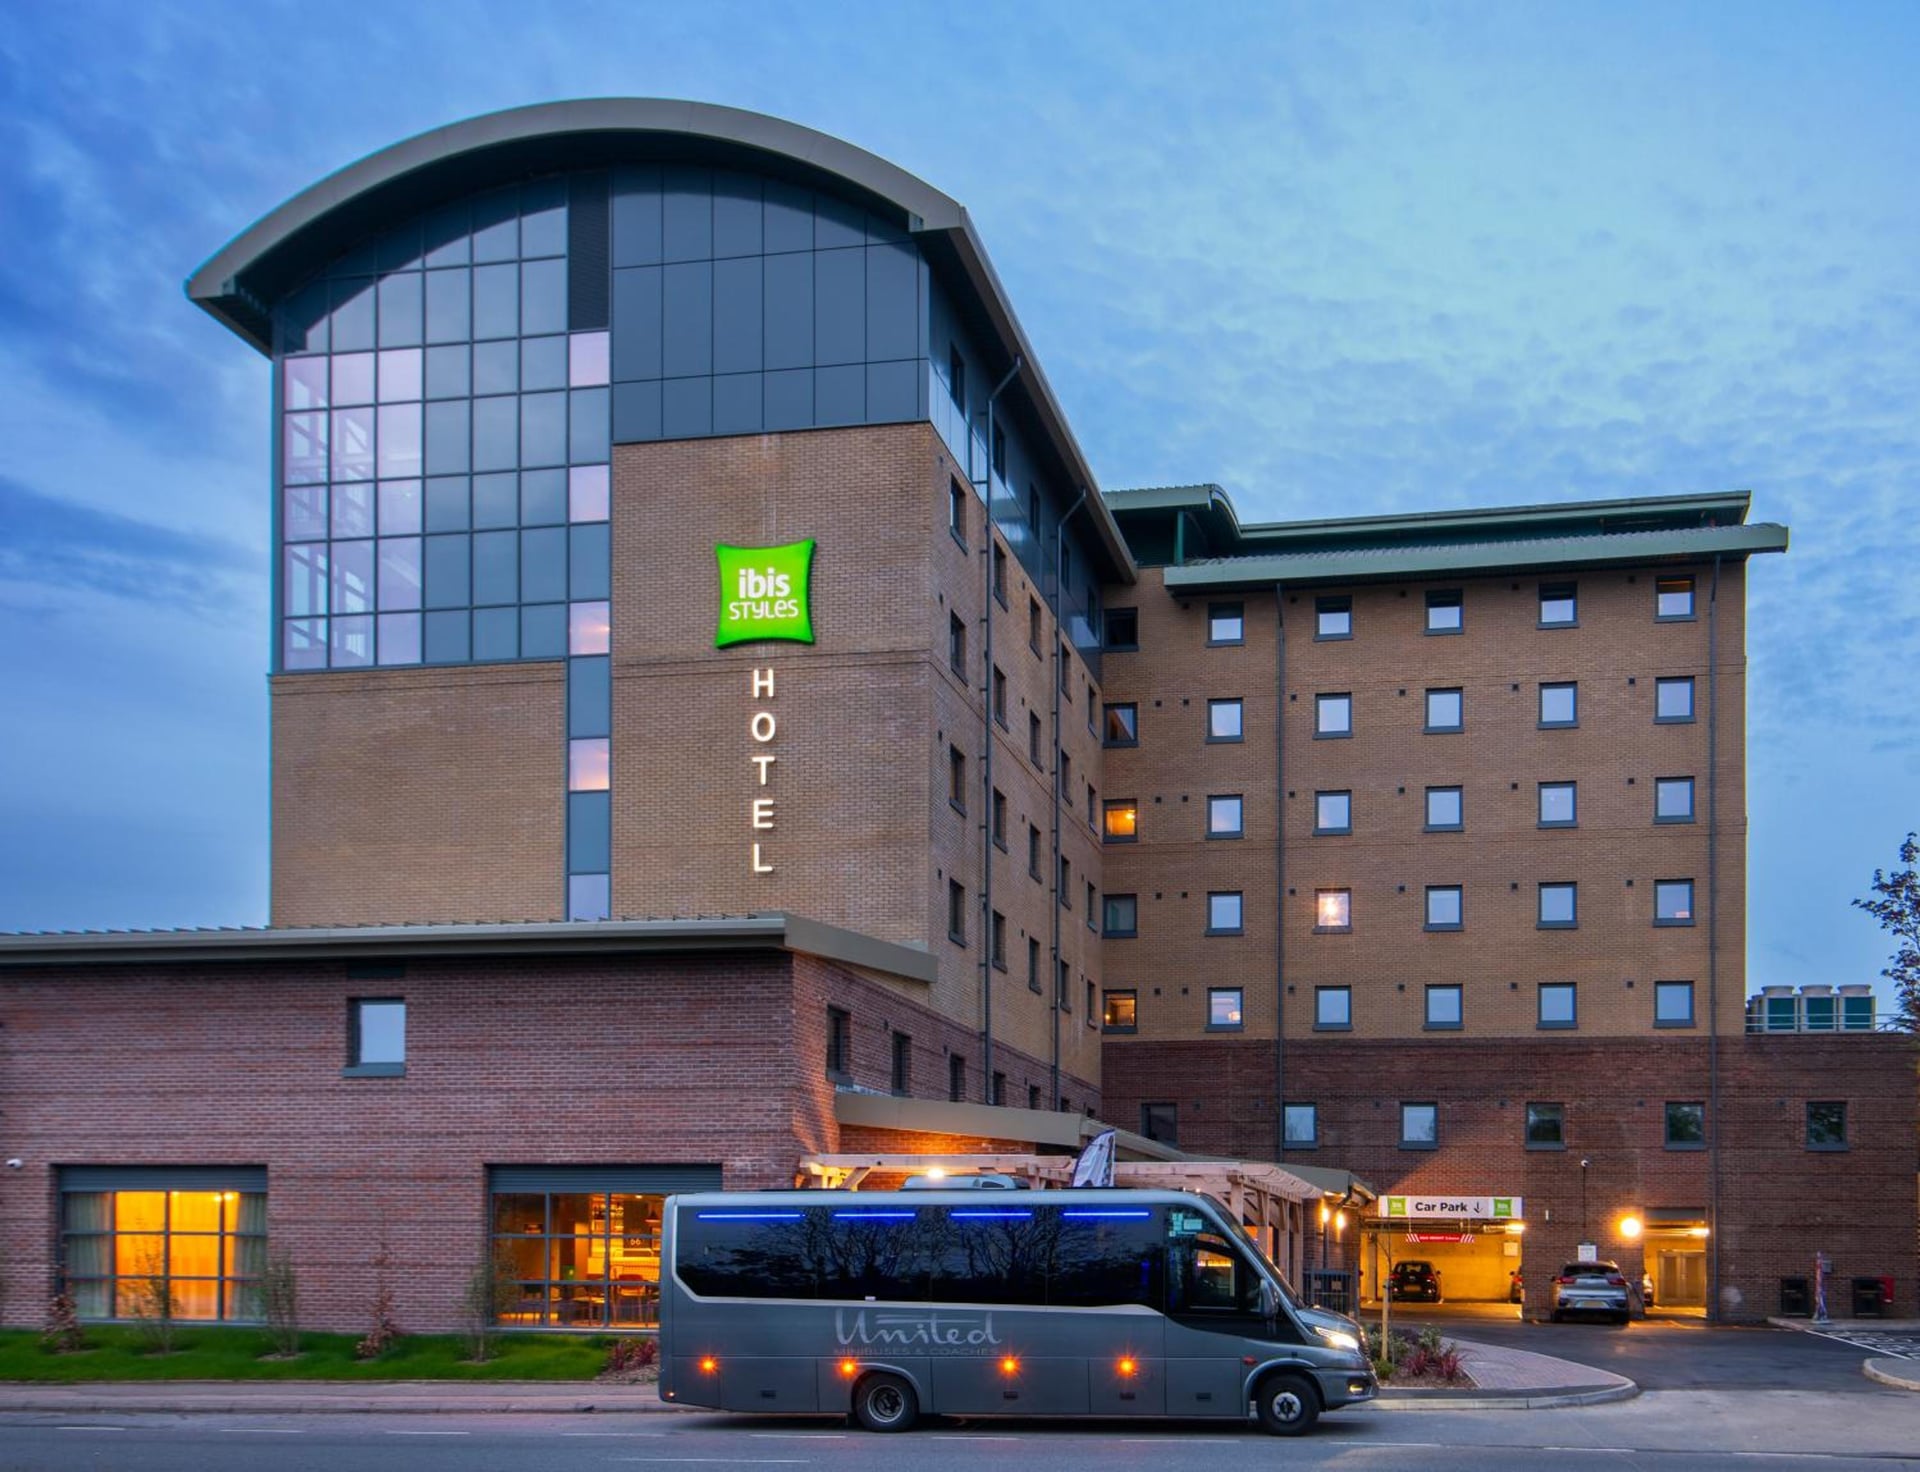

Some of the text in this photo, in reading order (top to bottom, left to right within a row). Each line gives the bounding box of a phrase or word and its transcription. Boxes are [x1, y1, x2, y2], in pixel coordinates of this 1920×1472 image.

[739, 567, 791, 598] ibis
[751, 668, 776, 872] HOTEL
[1415, 1202, 1436, 1212] Car
[1440, 1202, 1468, 1212] Park
[835, 1308, 1002, 1345] United
